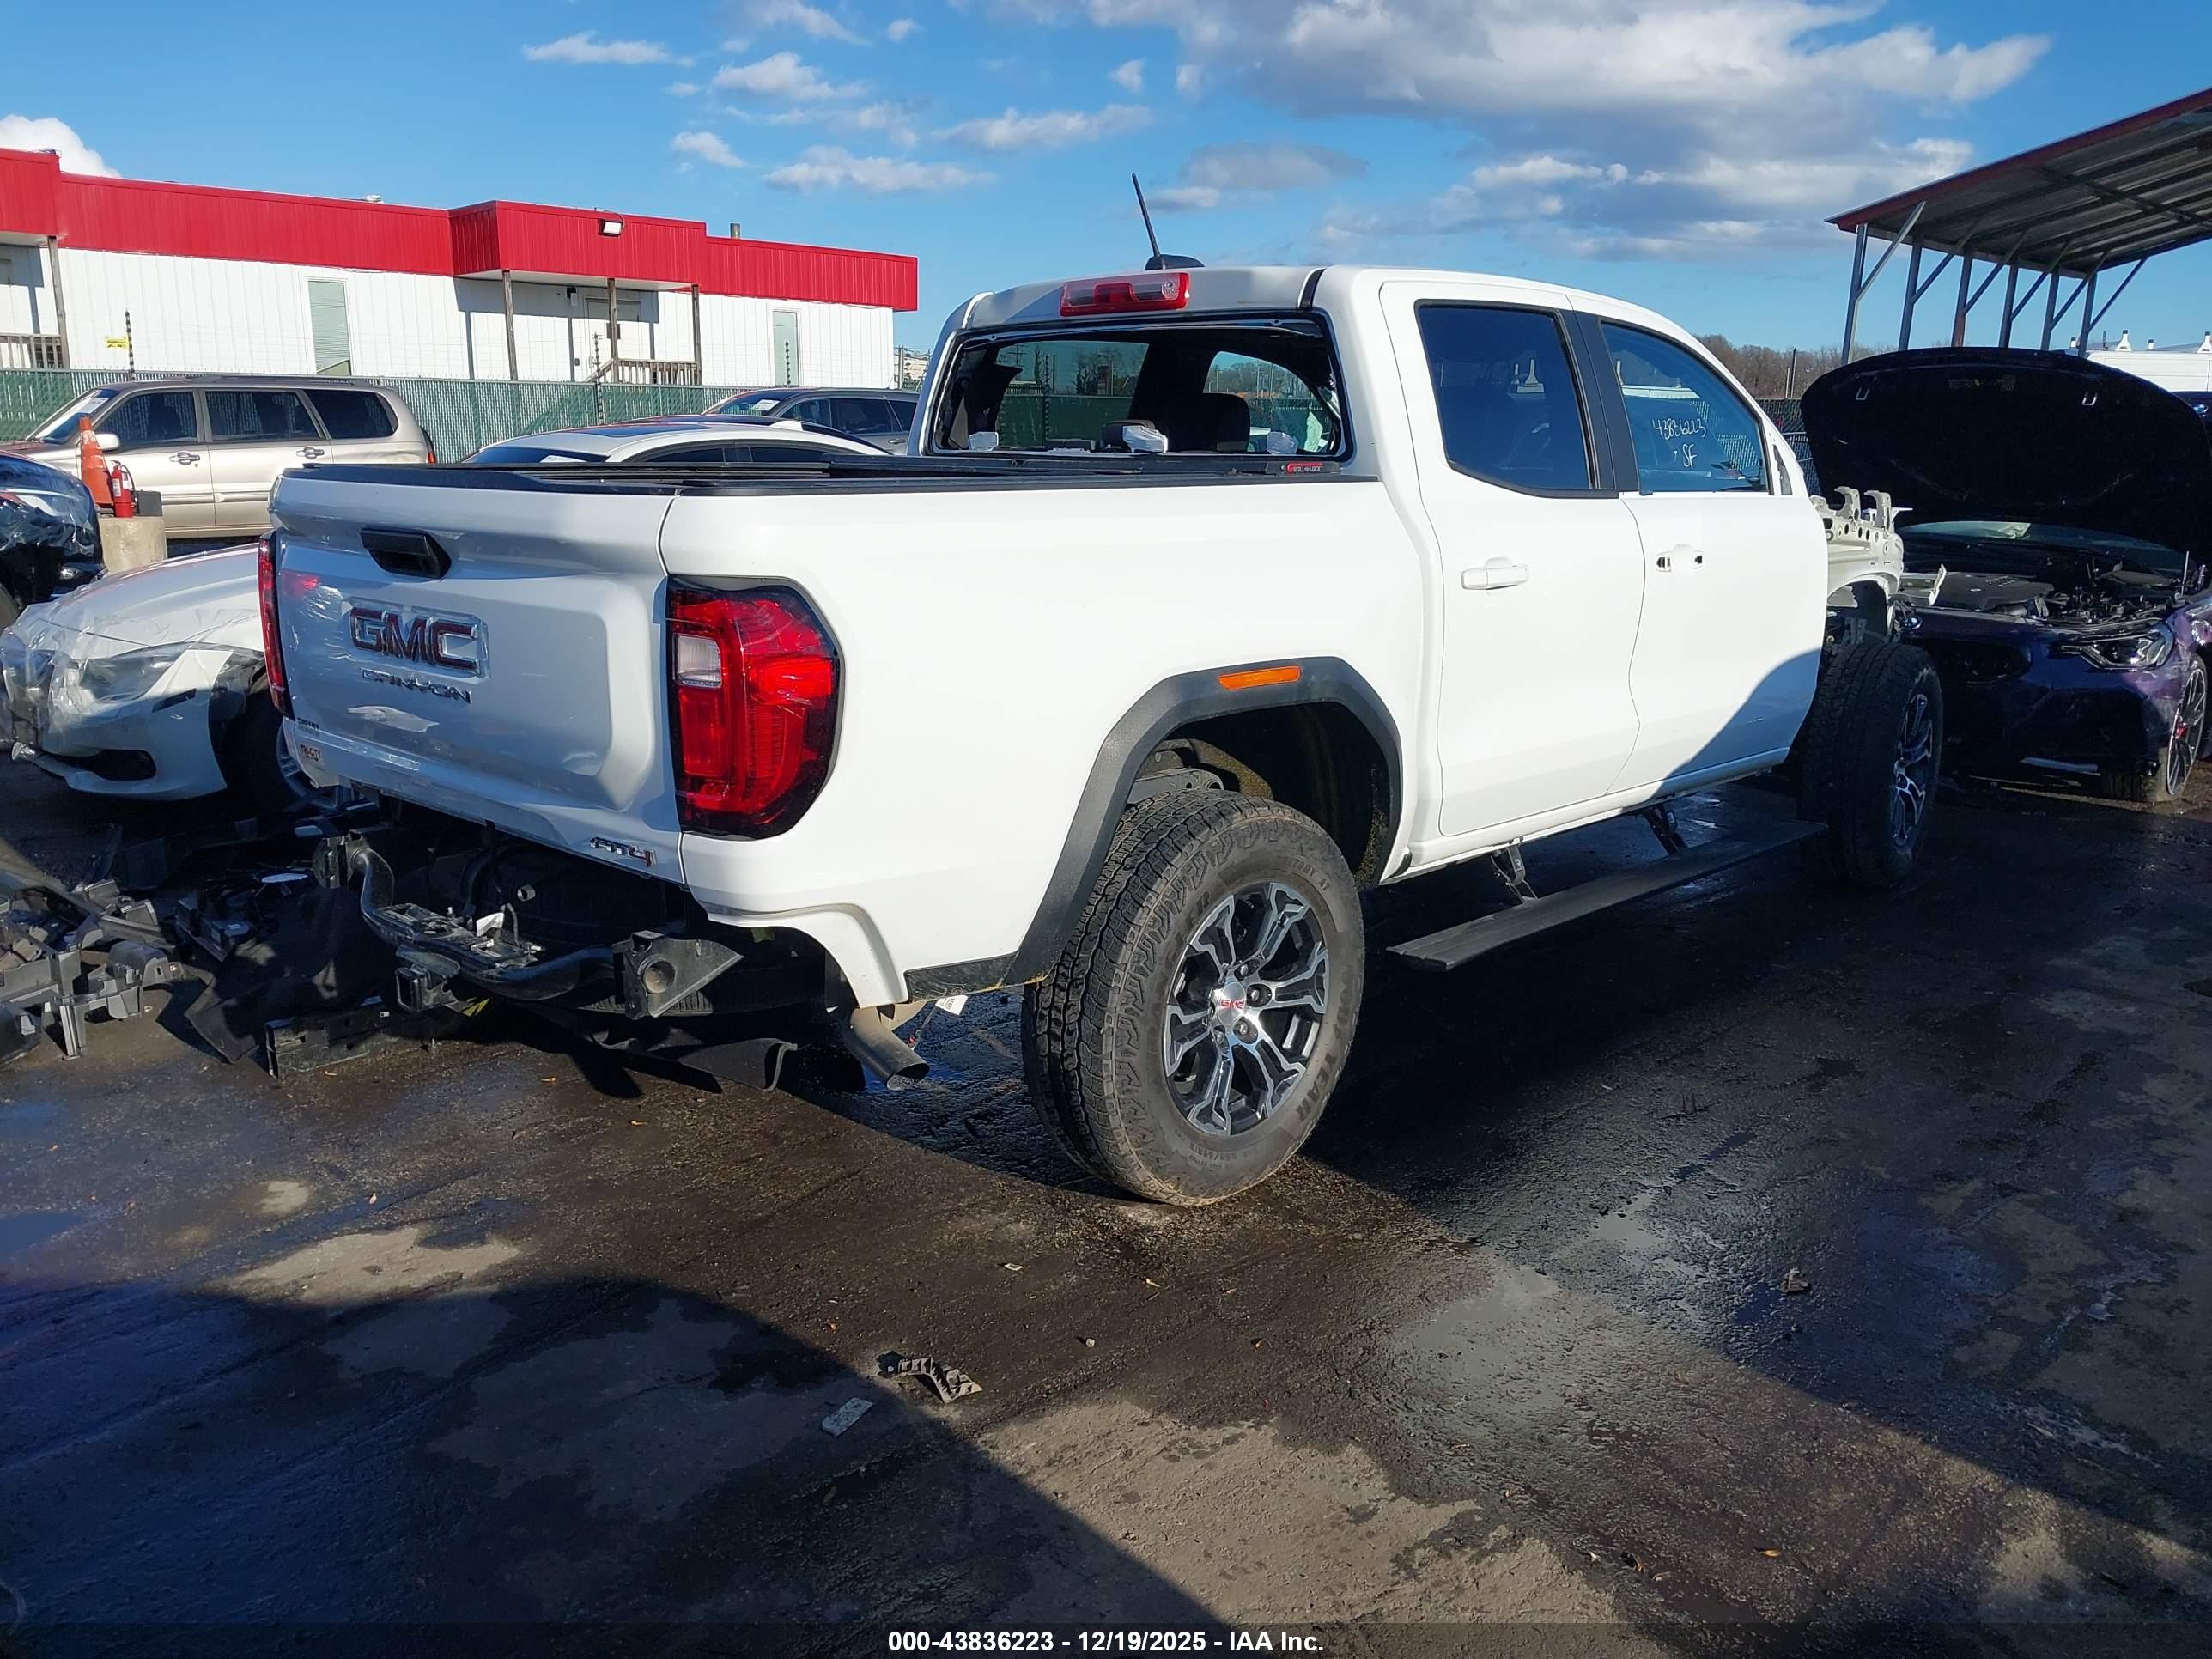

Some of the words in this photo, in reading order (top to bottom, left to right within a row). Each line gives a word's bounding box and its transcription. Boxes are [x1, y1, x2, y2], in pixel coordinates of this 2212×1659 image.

[1651, 418, 1706, 440] 43836223
[350, 606, 481, 675] GMC
[361, 667, 473, 704] CANYON
[590, 836, 658, 868] AT4
[1221, 998, 1244, 1010] GMC
